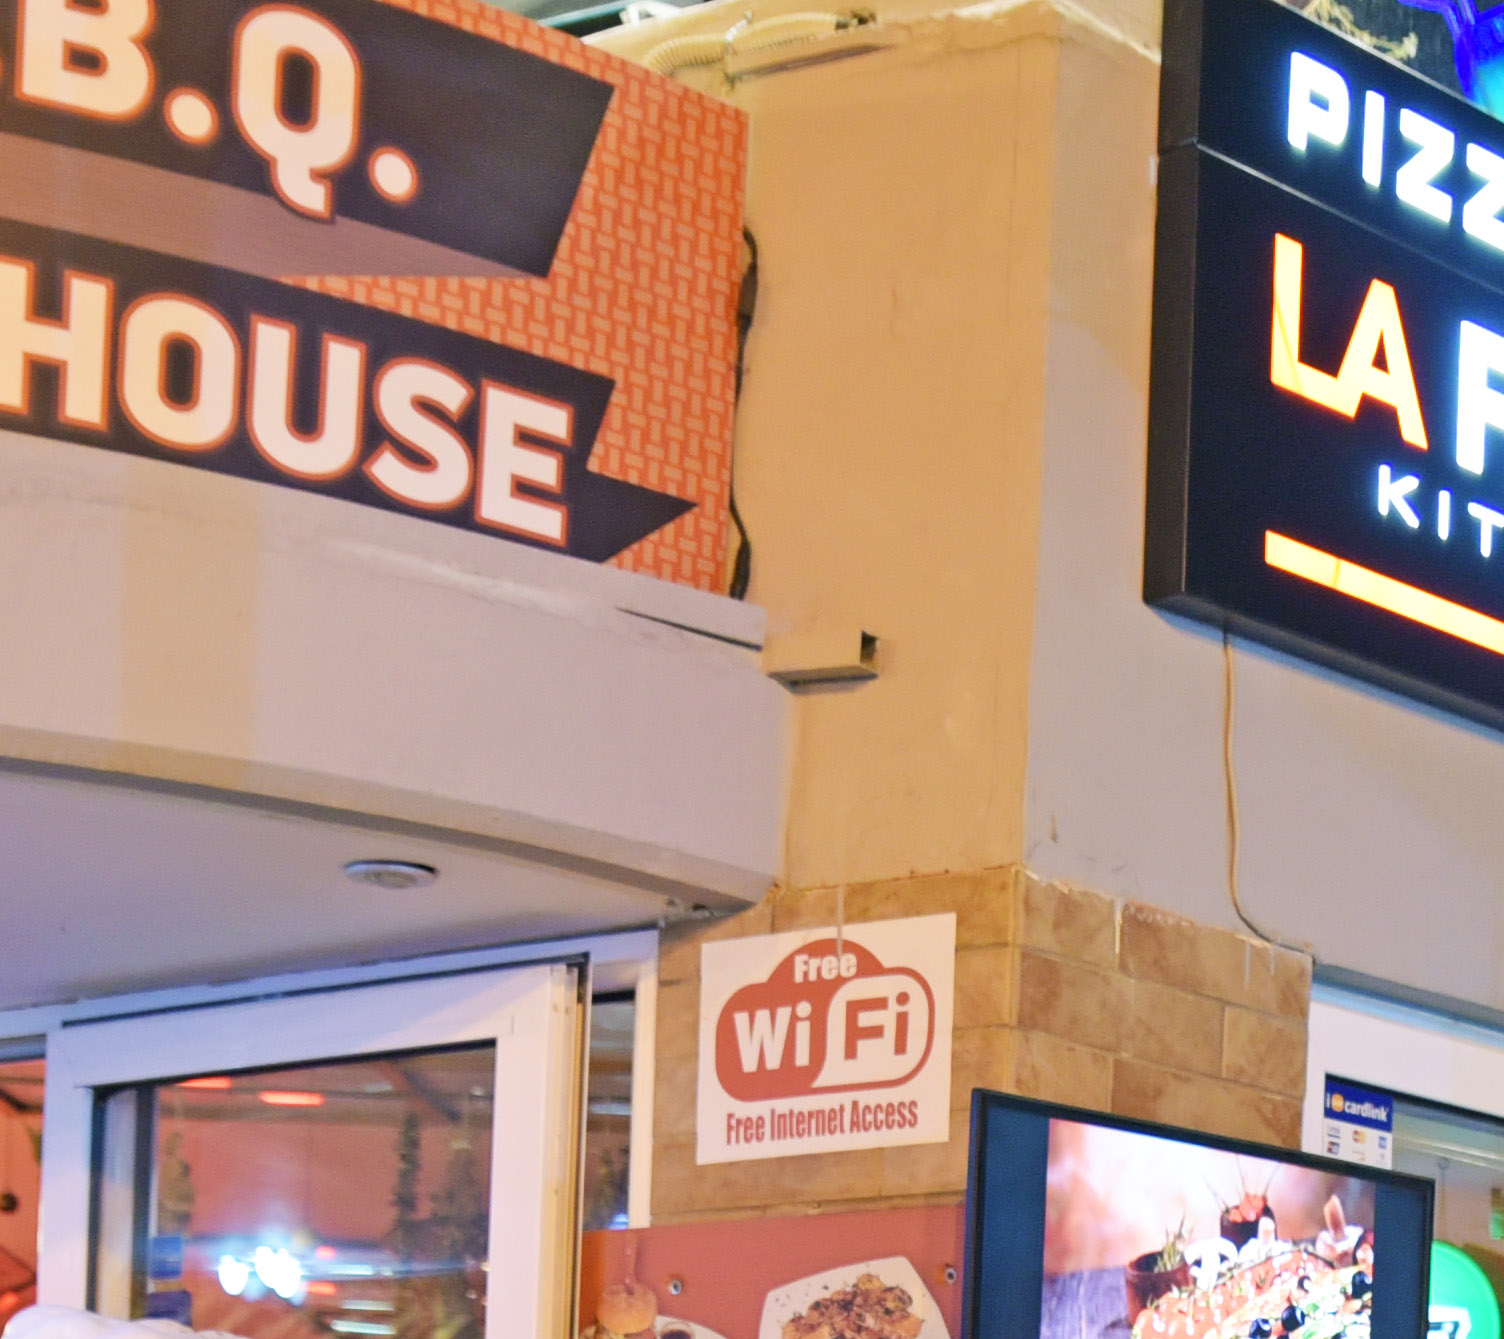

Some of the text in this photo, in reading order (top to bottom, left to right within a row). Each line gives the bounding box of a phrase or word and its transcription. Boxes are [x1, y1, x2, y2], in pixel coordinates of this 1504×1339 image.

[1270, 232, 1429, 450] LA
[792, 951, 858, 983] Free
[725, 1097, 919, 1147] Free Internet Access
[1344, 1100, 1389, 1122] cardlink
